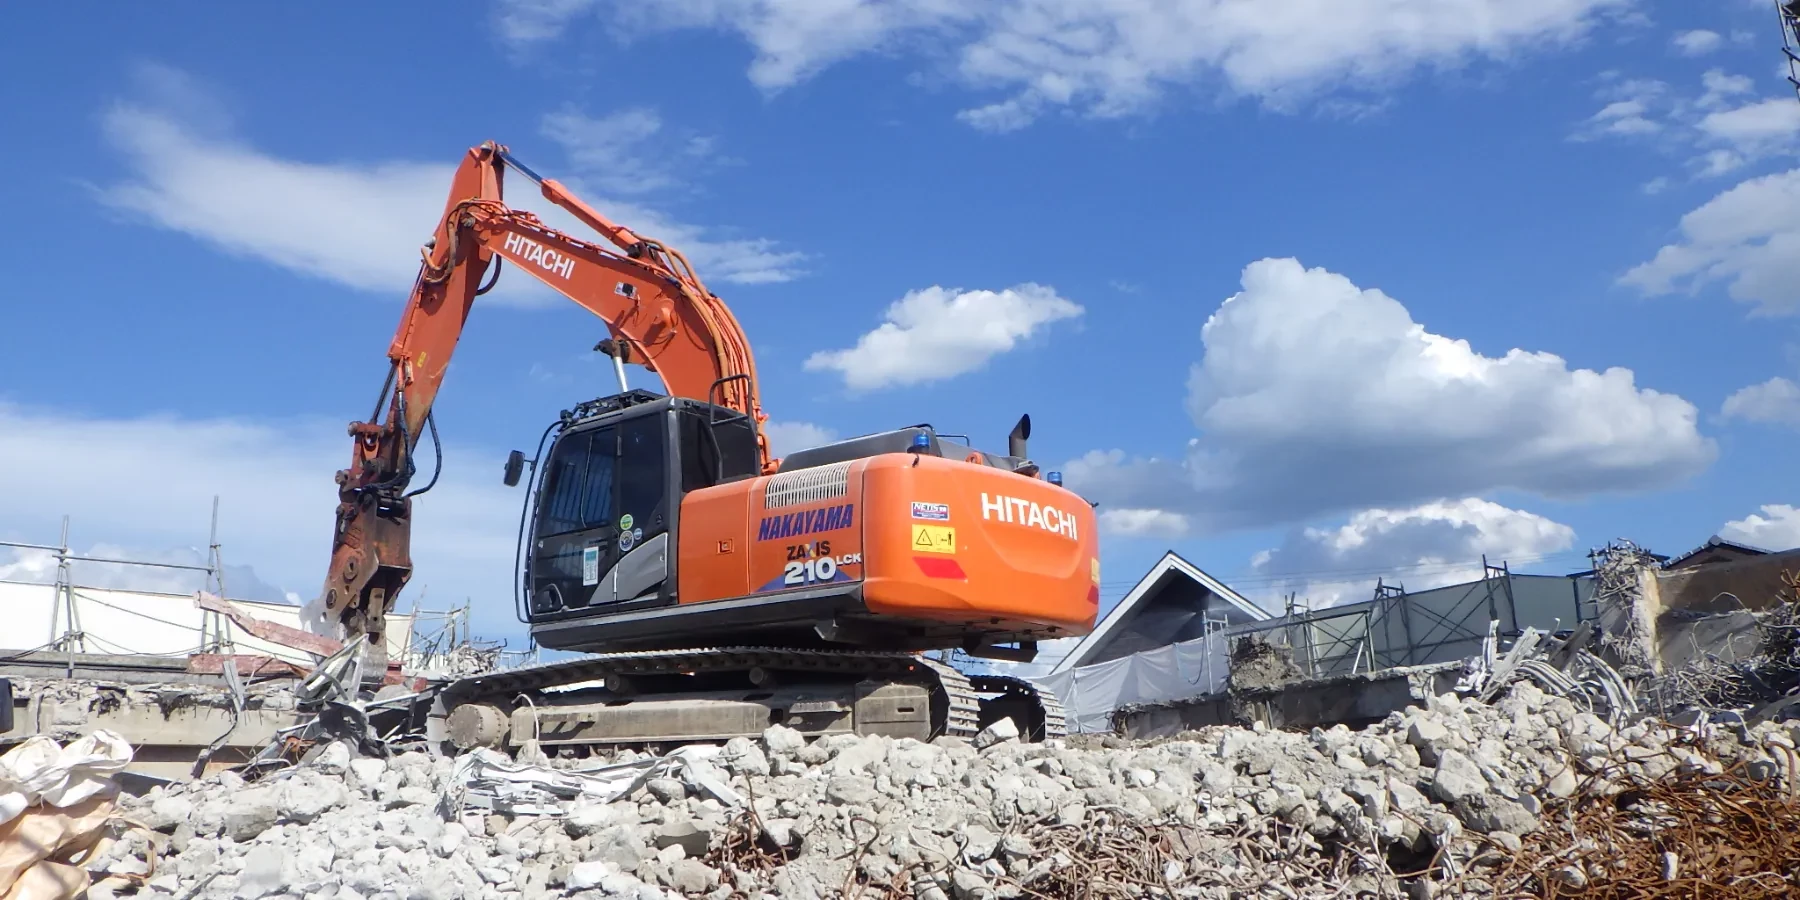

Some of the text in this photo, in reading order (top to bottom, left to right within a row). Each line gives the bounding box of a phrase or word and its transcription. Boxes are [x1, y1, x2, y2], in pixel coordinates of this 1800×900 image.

[504, 231, 576, 280] HITACHI
[758, 504, 854, 541] NAKAYAMA
[981, 492, 1078, 541] HITACHI
[787, 538, 831, 561] ZAXIS
[784, 552, 862, 586] 210 LCK
